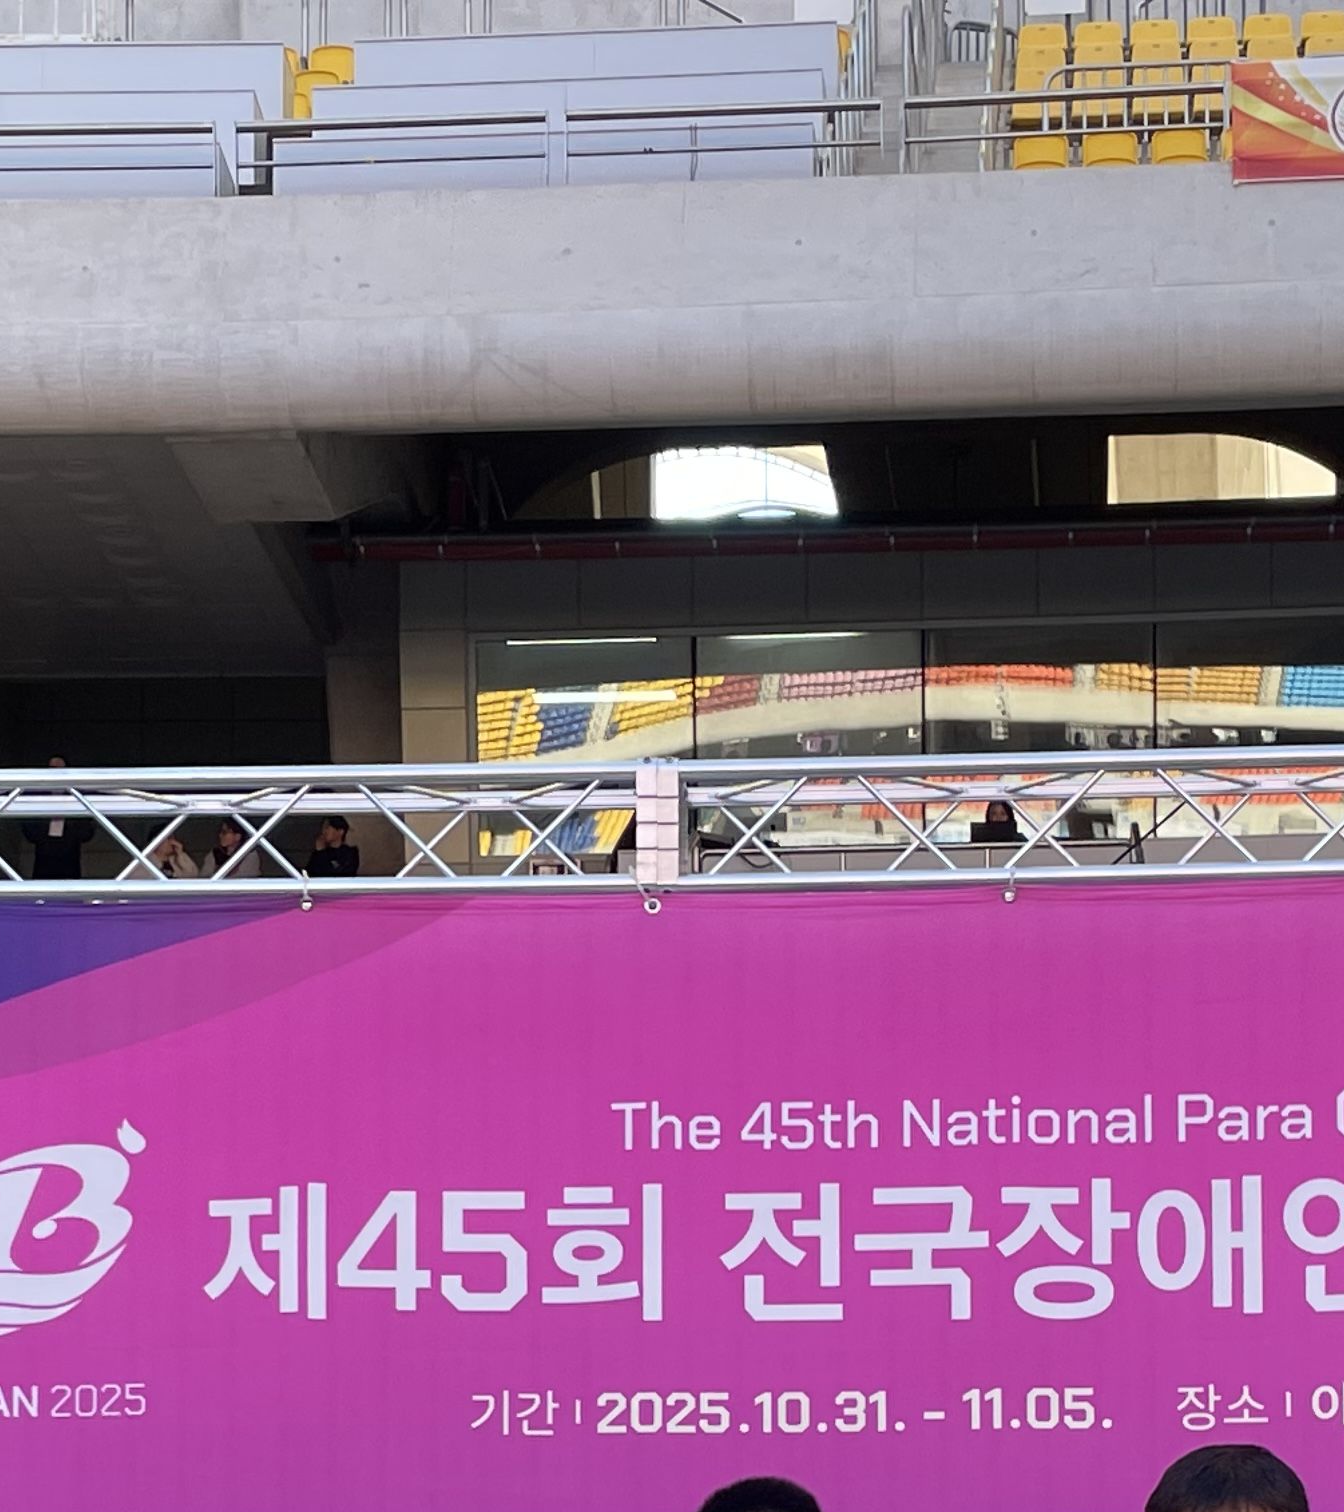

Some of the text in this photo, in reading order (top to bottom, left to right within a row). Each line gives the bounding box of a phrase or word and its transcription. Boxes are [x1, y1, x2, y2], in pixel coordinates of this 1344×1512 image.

[610, 1102, 720, 1151] The
[741, 1099, 880, 1150] 45th
[901, 1094, 1154, 1147] National
[1175, 1093, 1313, 1143] Para
[203, 1180, 665, 1322] 제45회
[50, 1383, 147, 1419] 2025
[468, 1390, 560, 1437] 기간
[596, 1391, 906, 1434] 2025.10.31.
[962, 1388, 1114, 1431] 11.05.
[1176, 1385, 1263, 1429] 장소
